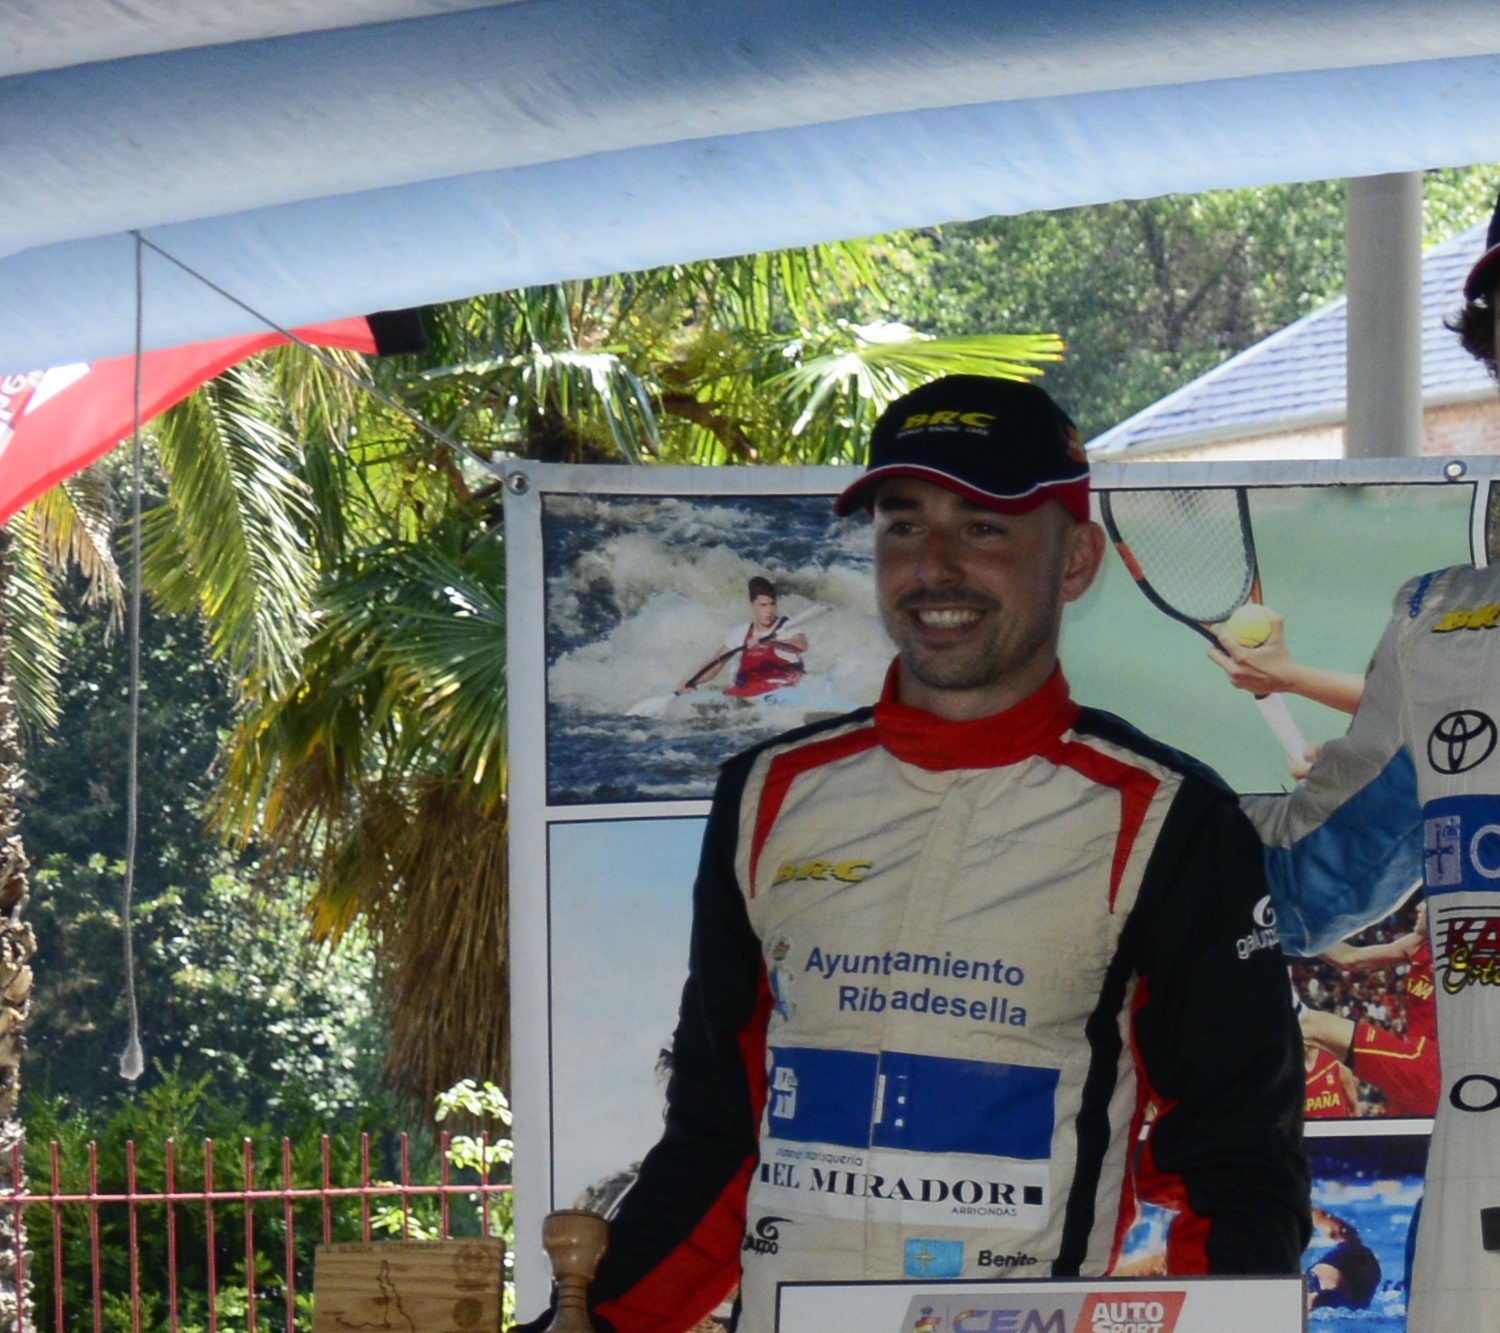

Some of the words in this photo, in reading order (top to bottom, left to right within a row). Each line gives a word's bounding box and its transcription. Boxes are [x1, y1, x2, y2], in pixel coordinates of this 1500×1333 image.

[901, 410, 997, 430] BRC
[771, 859, 874, 886] BRC
[804, 946, 1025, 987] Ayuntamiento
[837, 985, 1028, 1028] Ribadesella
[1306, 1092, 1342, 1112] PAÑA
[772, 1162, 801, 1190] EL
[809, 1166, 1018, 1206] MIRADOR
[950, 1206, 1018, 1217] ARRIONDAS
[977, 1249, 1038, 1269] Benito
[1091, 1301, 1165, 1323] AUTO
